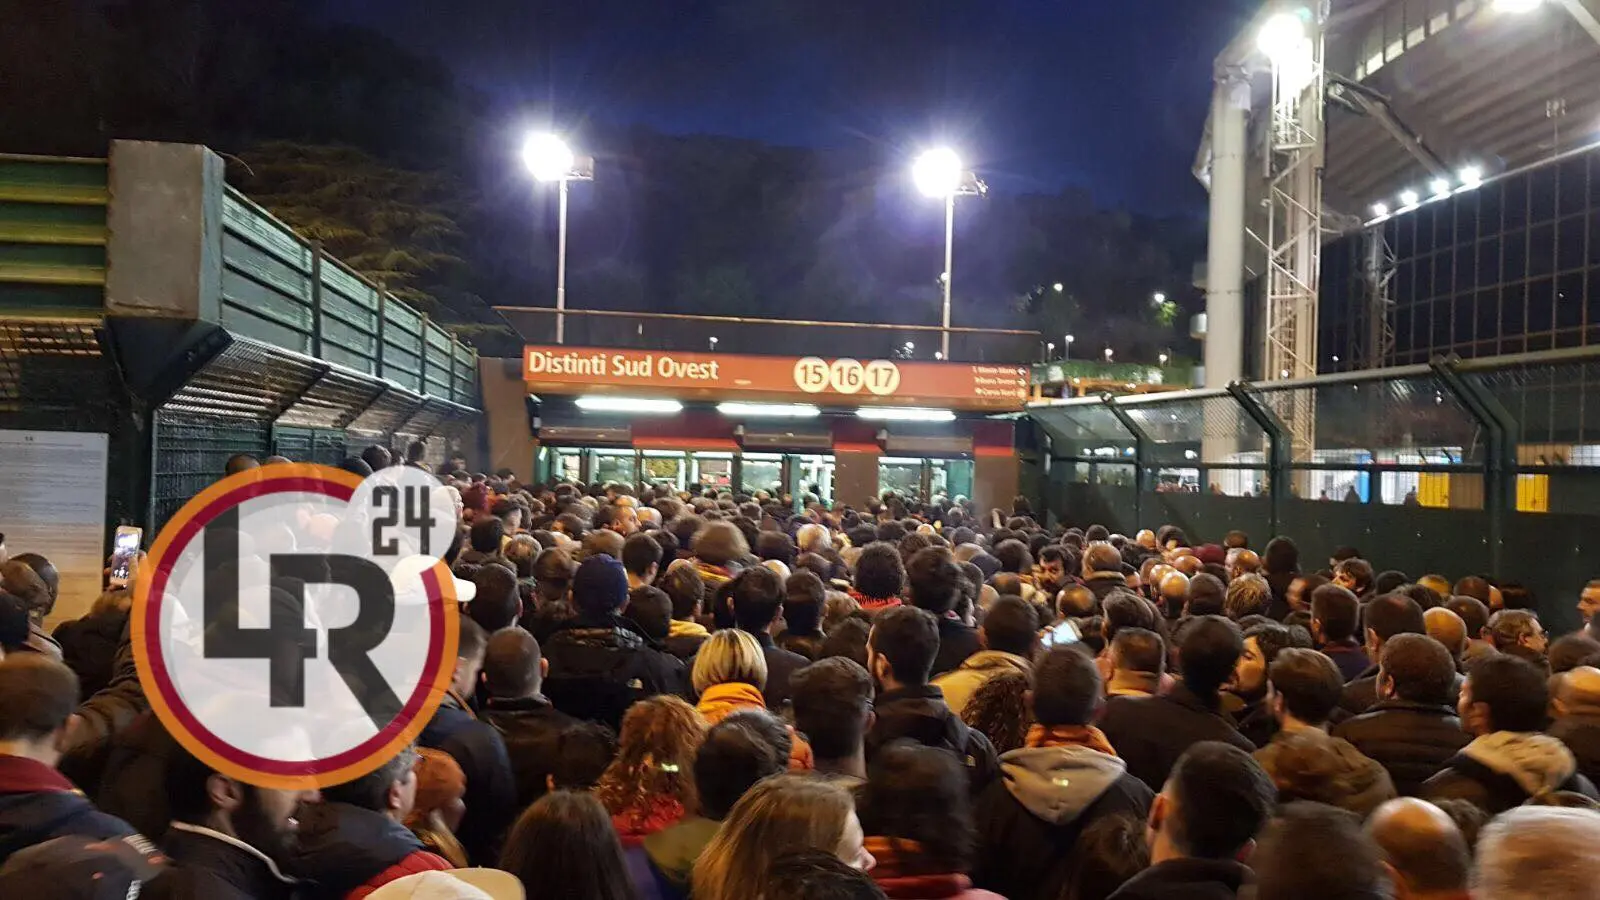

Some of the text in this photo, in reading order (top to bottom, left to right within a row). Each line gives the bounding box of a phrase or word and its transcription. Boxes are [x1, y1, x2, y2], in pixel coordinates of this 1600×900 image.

[529, 351, 719, 380] Distinti Sud Ovest
[800, 364, 894, 388] 15 16 17
